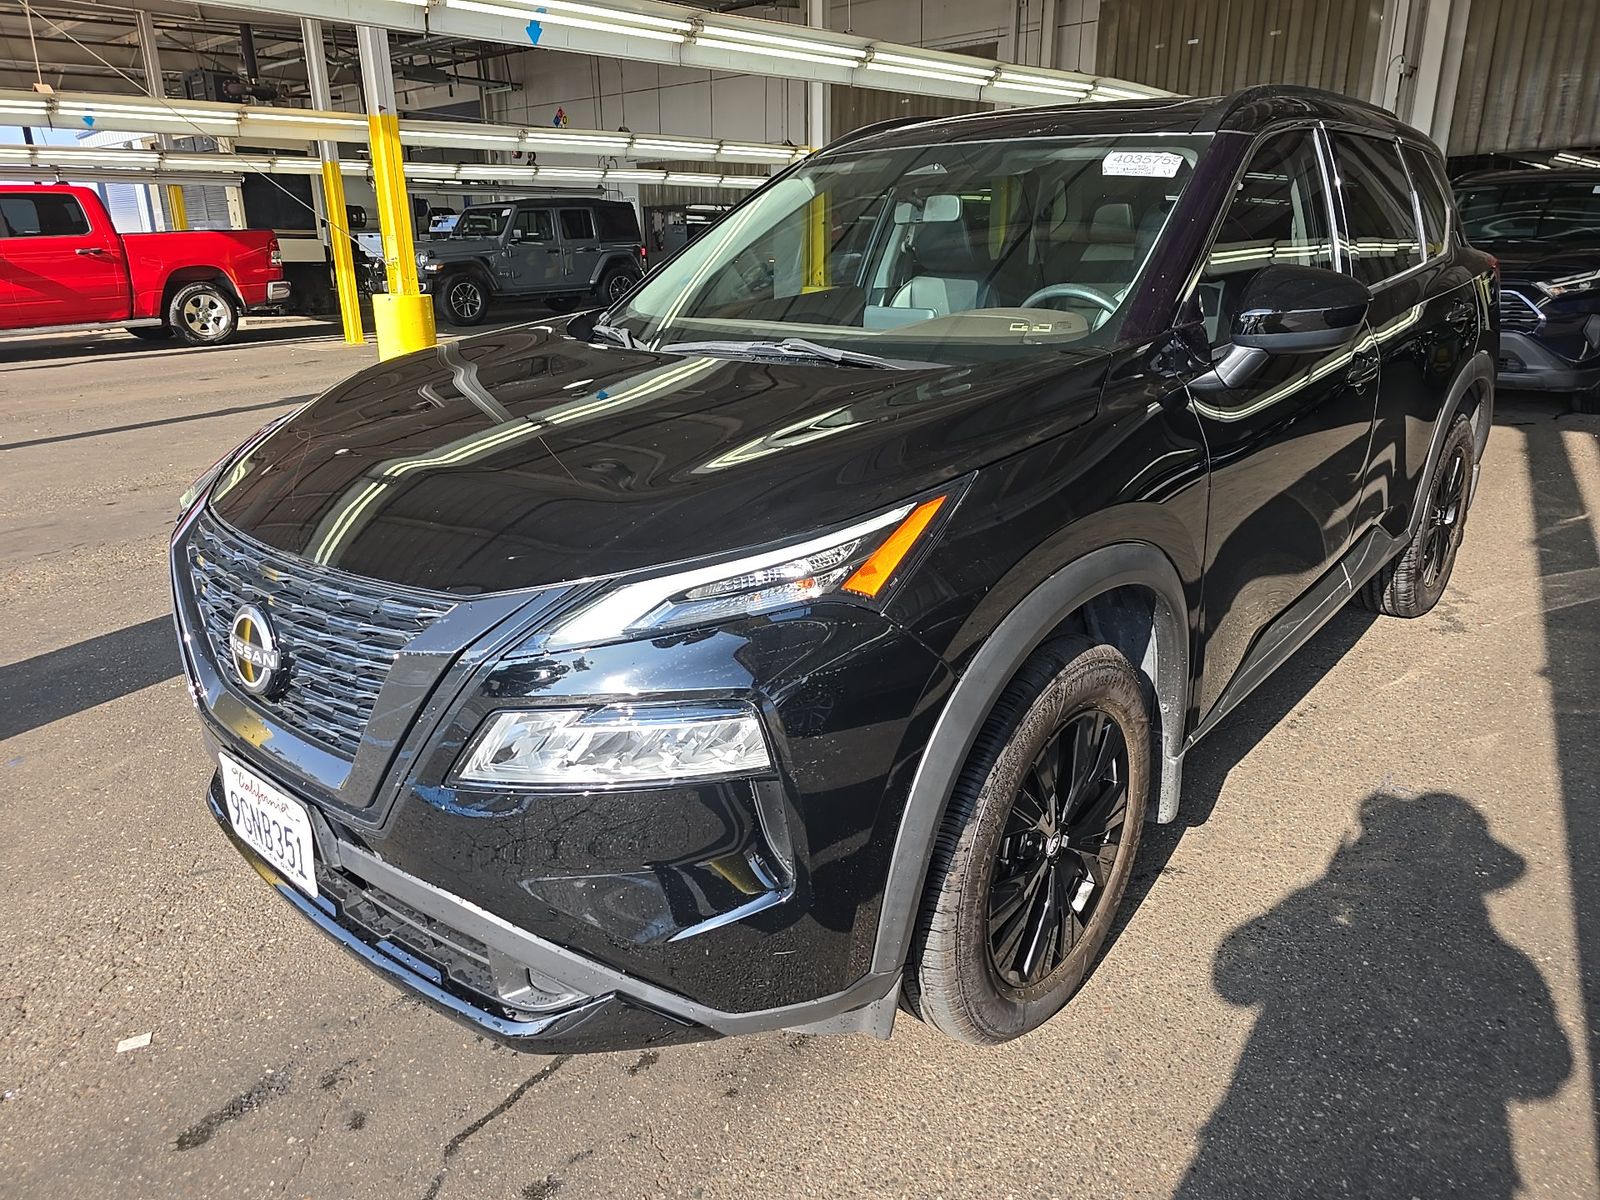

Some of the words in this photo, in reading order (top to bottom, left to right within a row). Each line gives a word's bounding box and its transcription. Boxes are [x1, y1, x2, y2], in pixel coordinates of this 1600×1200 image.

[230, 632, 278, 668] NISSAN
[238, 771, 291, 816] California
[231, 790, 307, 880] 9GNB351
